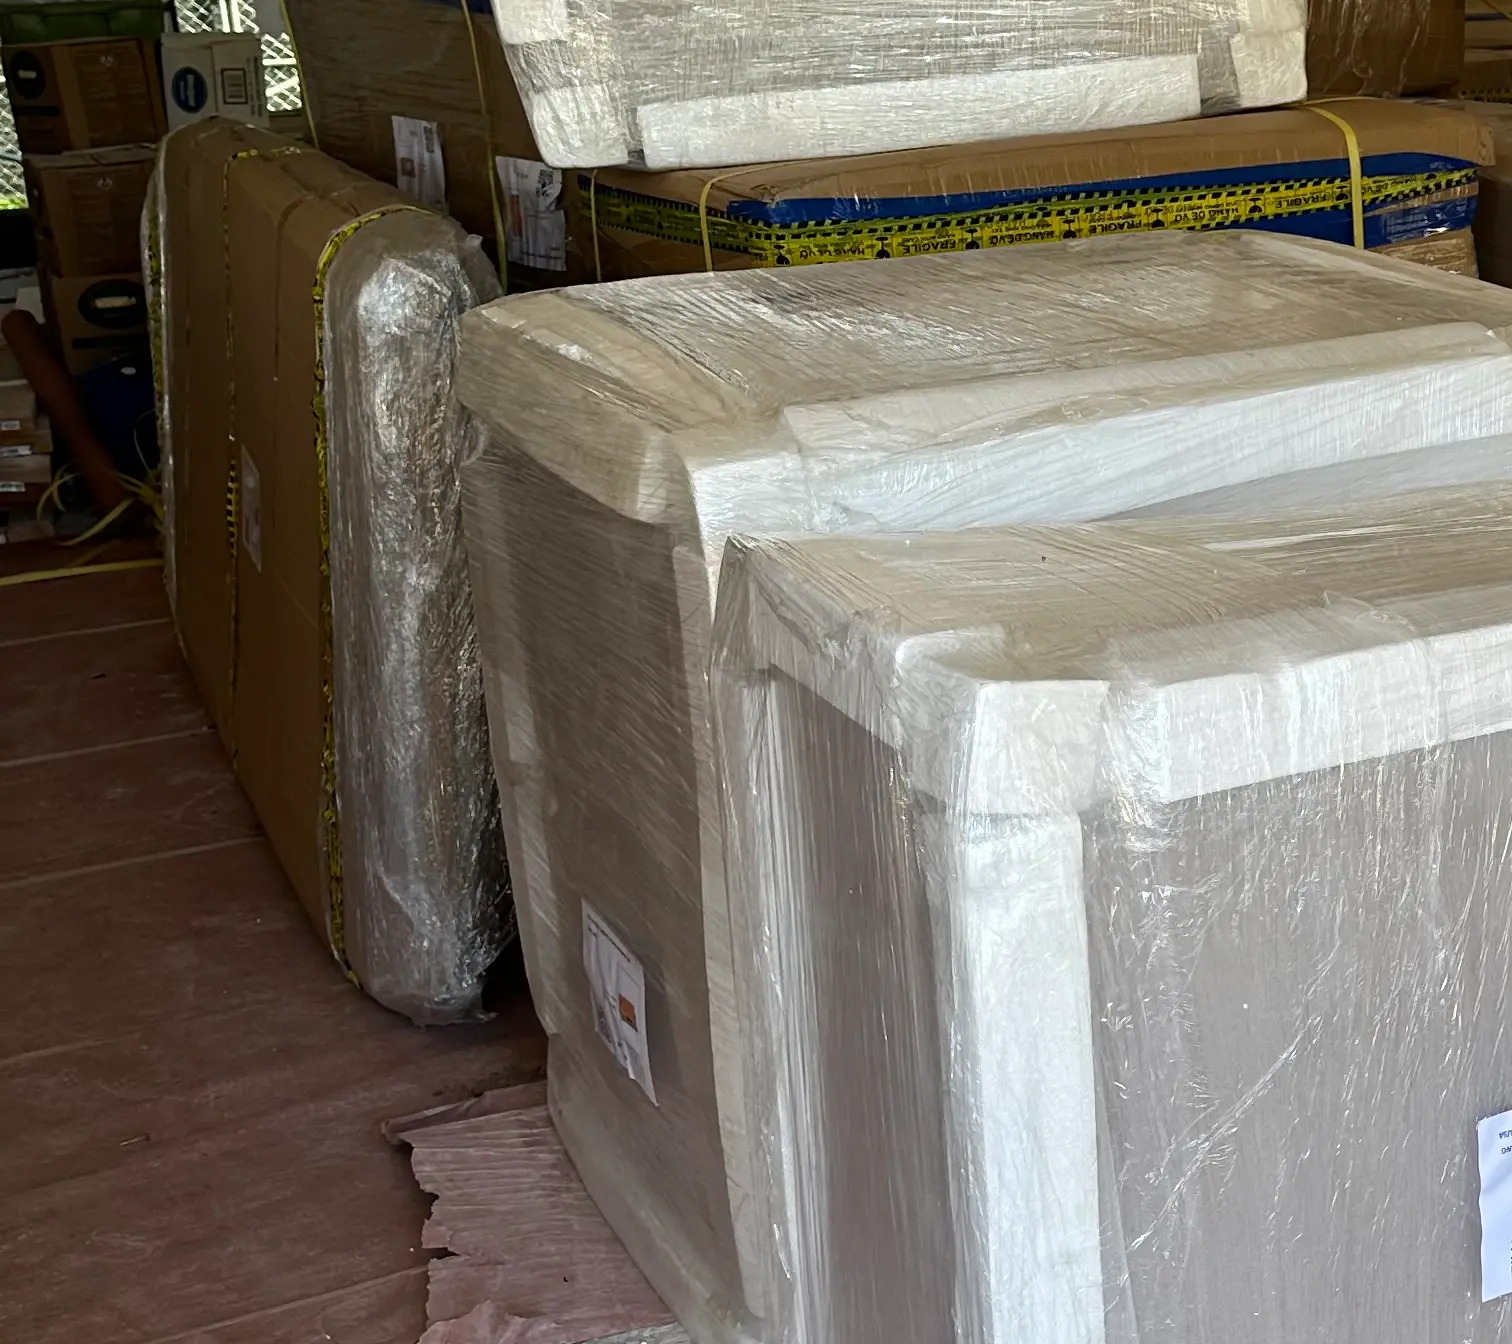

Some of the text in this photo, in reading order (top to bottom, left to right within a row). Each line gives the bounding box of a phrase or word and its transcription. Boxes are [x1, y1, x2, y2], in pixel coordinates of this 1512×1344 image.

[1274, 194, 1327, 209] FRAGILE
[1088, 220, 1142, 235] FRAGILE
[902, 240, 956, 255] FRAGILE
[1498, 1129, 1512, 1140] USA
